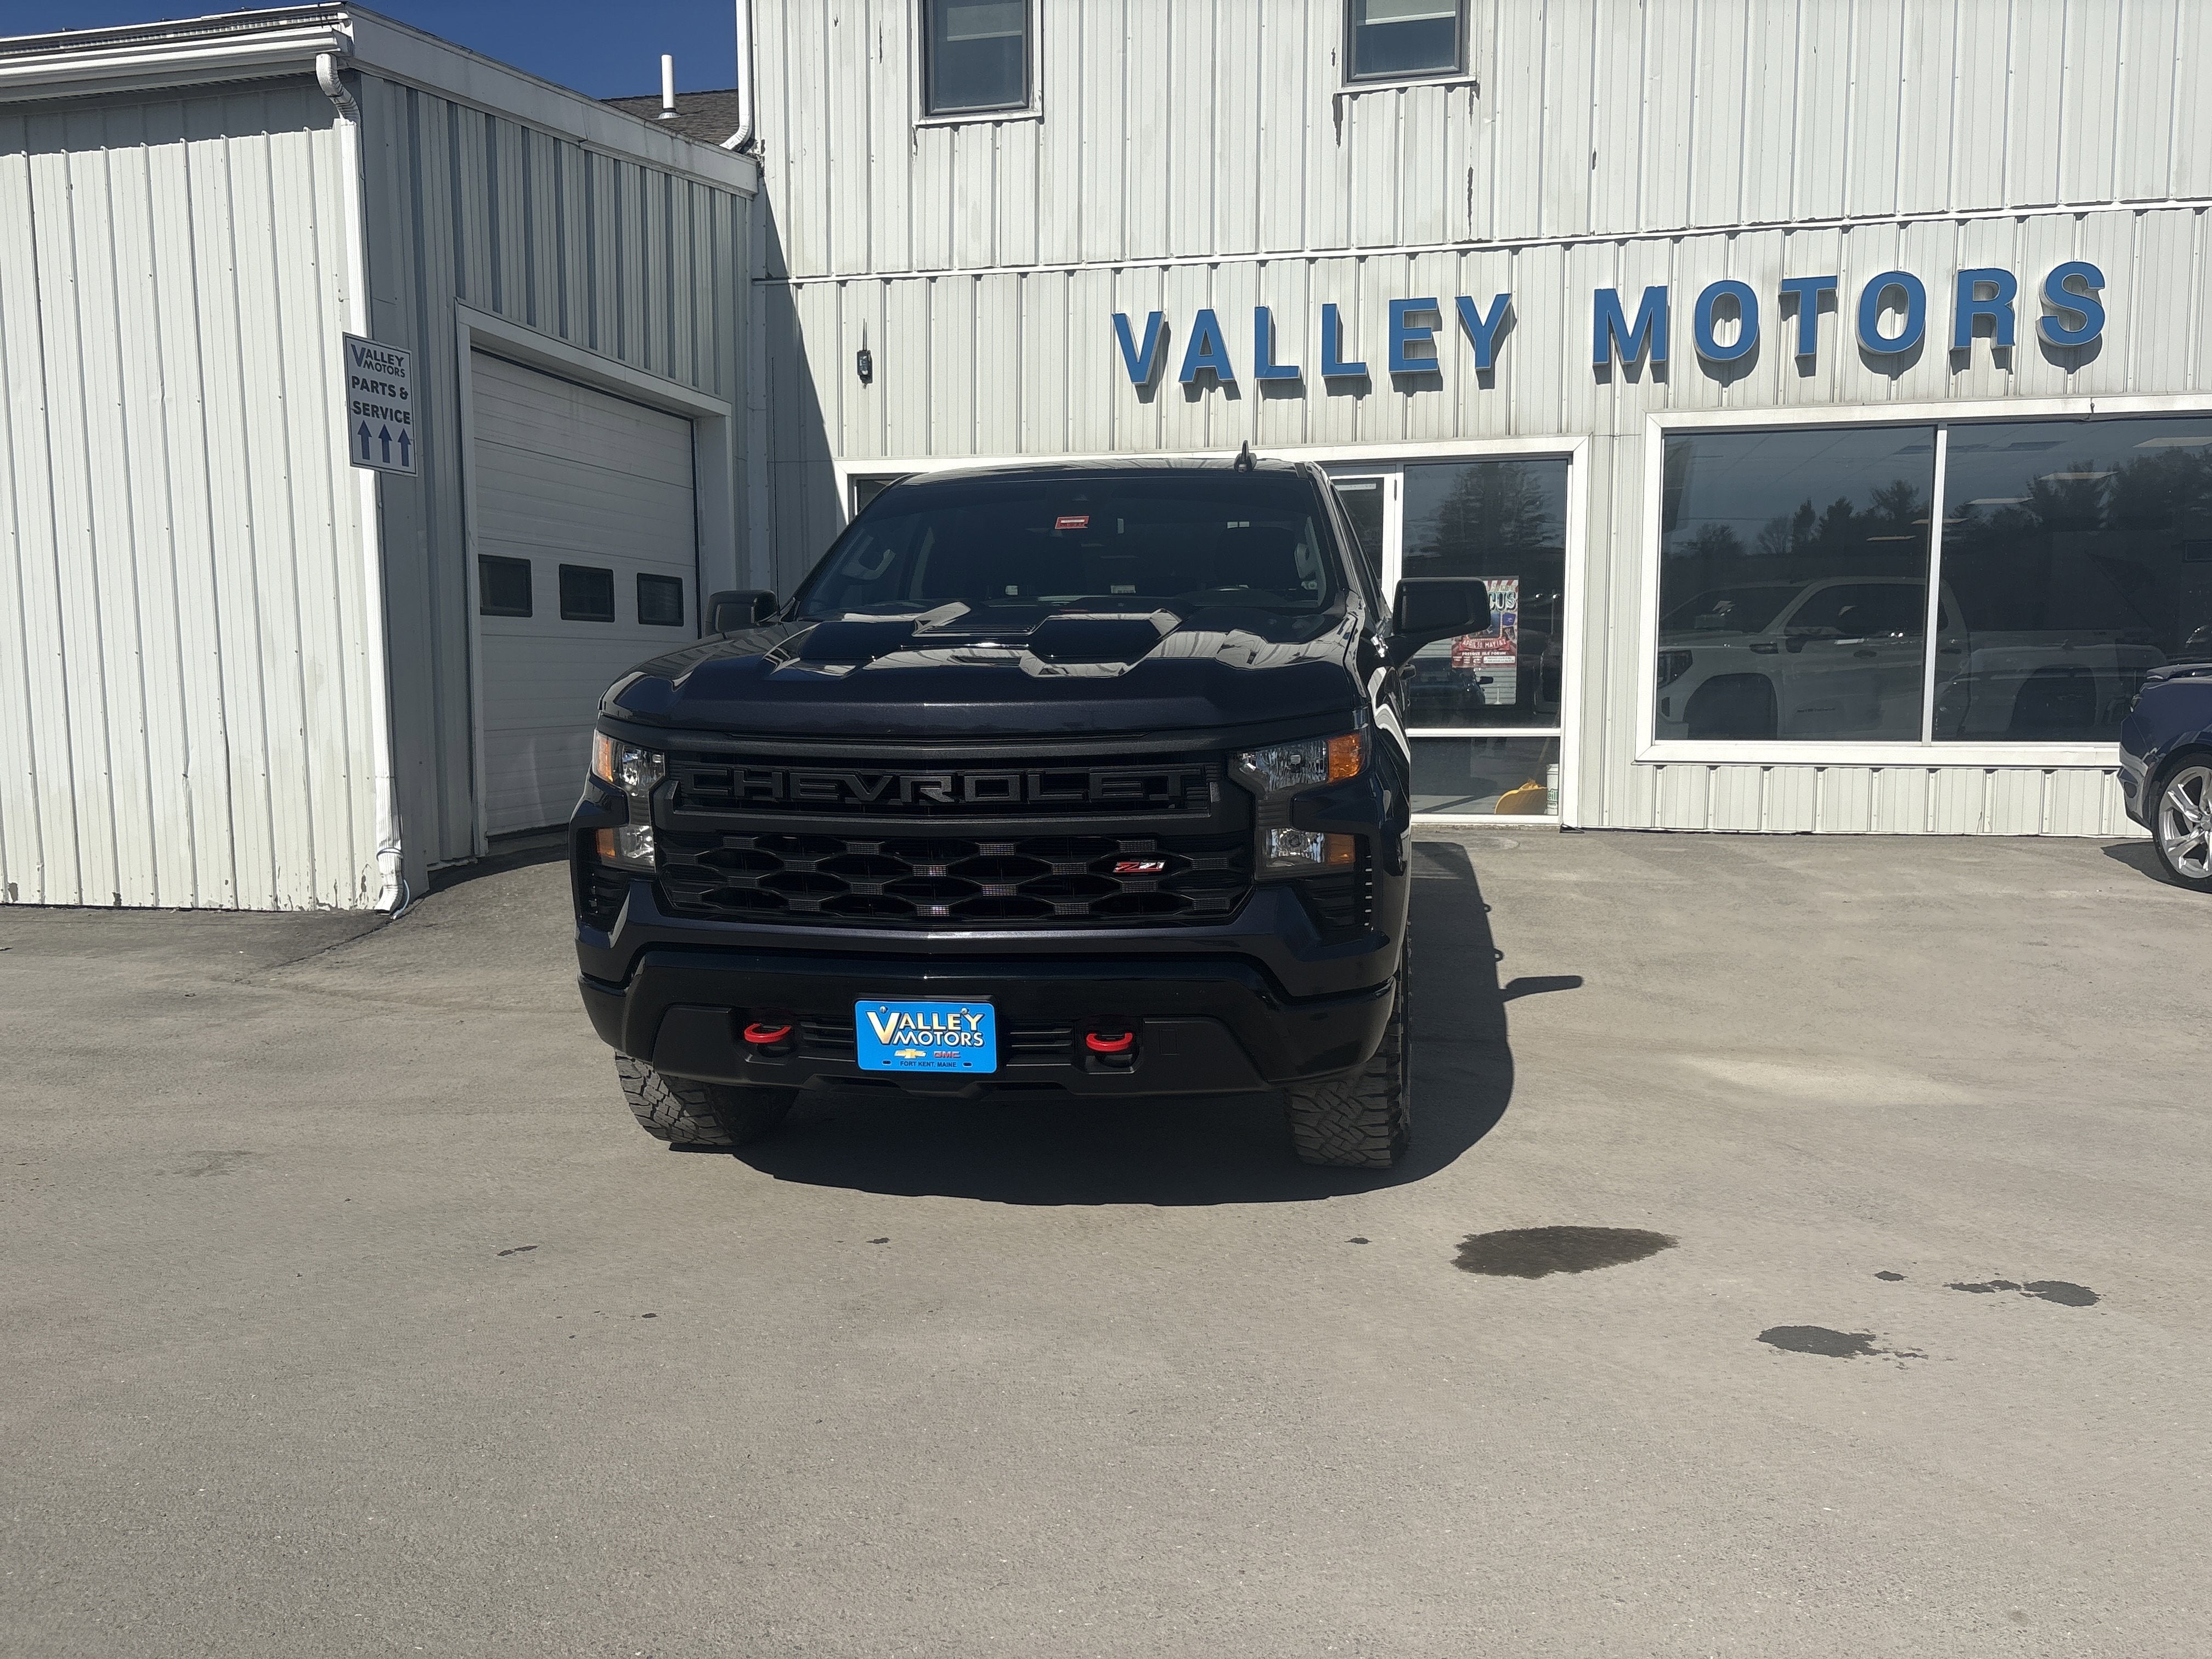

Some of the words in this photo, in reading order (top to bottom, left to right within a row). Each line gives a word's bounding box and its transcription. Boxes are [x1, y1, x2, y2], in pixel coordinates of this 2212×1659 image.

[1112, 294, 1513, 386] VALLEY
[1592, 261, 2107, 366] MOTORS
[351, 343, 404, 368] VALLEY
[363, 361, 405, 378] MOTORS
[351, 375, 397, 398] PARTS
[399, 386, 409, 400] &
[352, 400, 411, 425] SERVICE
[1488, 591, 1516, 611] CUS
[1462, 640, 1476, 648] APRIL
[680, 767, 1201, 803] CHEVROLET
[865, 1011, 986, 1045] VALLEY
[892, 1030, 985, 1047] MOTORS
[933, 1050, 961, 1059] GMC
